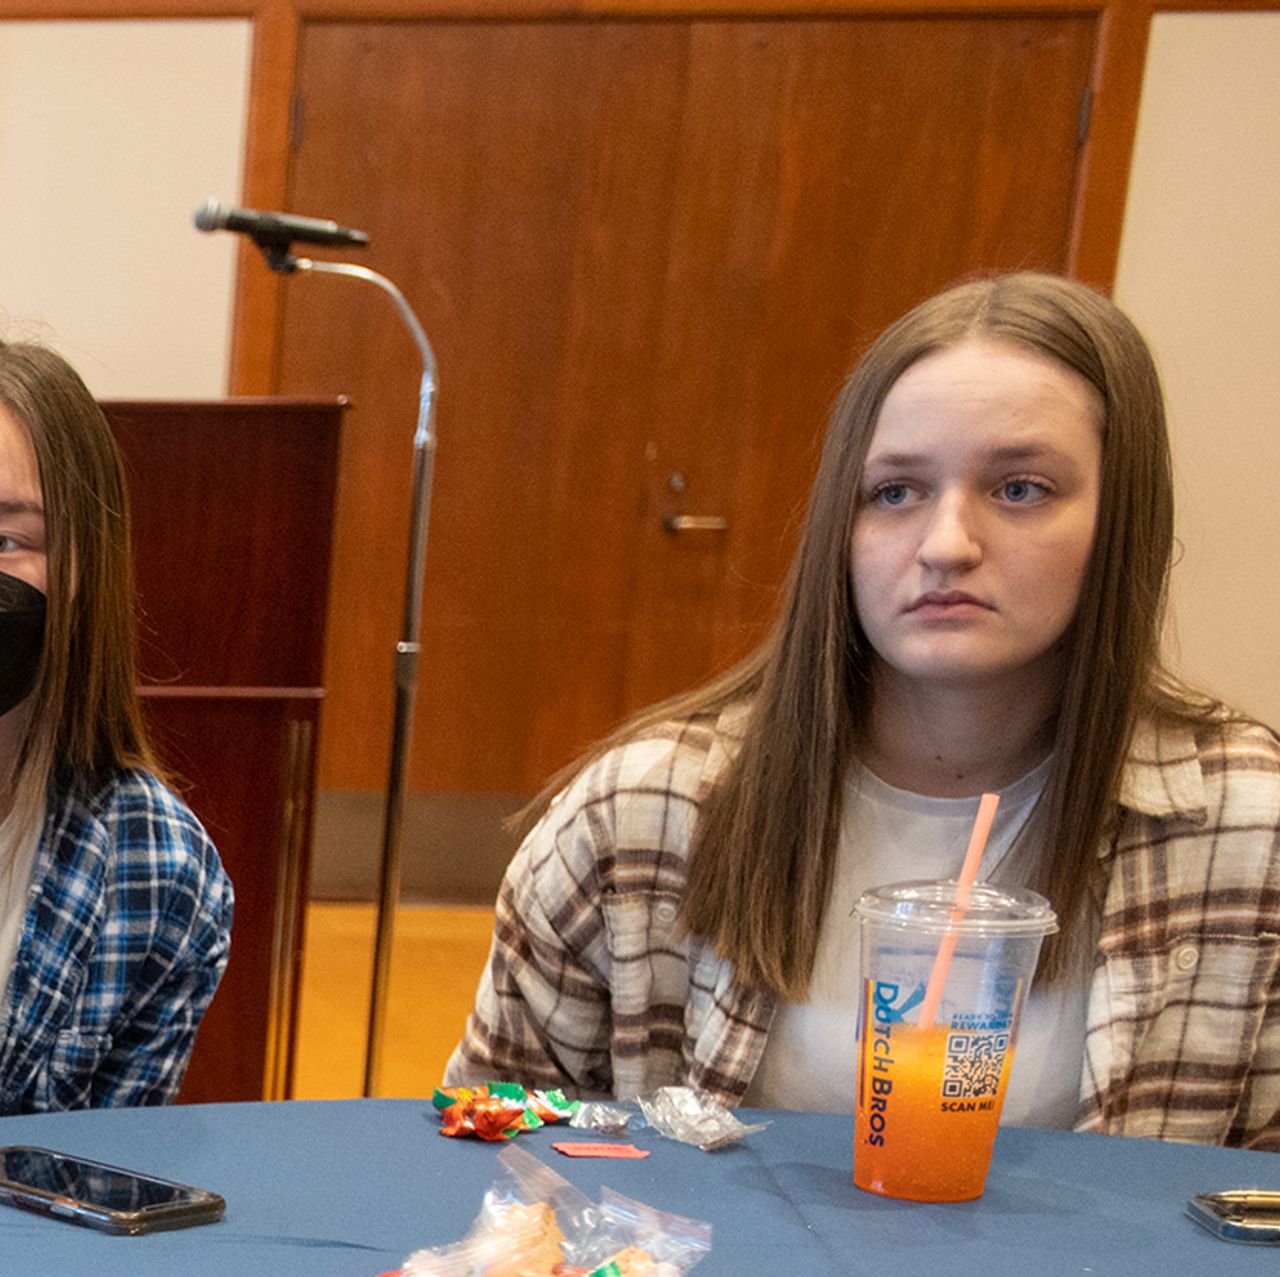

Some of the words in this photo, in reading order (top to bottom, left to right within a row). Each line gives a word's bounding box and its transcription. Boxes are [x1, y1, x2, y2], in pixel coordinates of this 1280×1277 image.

[873, 980, 899, 1073] DUTCH
[869, 1076, 893, 1147] BROS
[940, 1102, 976, 1112] SCAN
